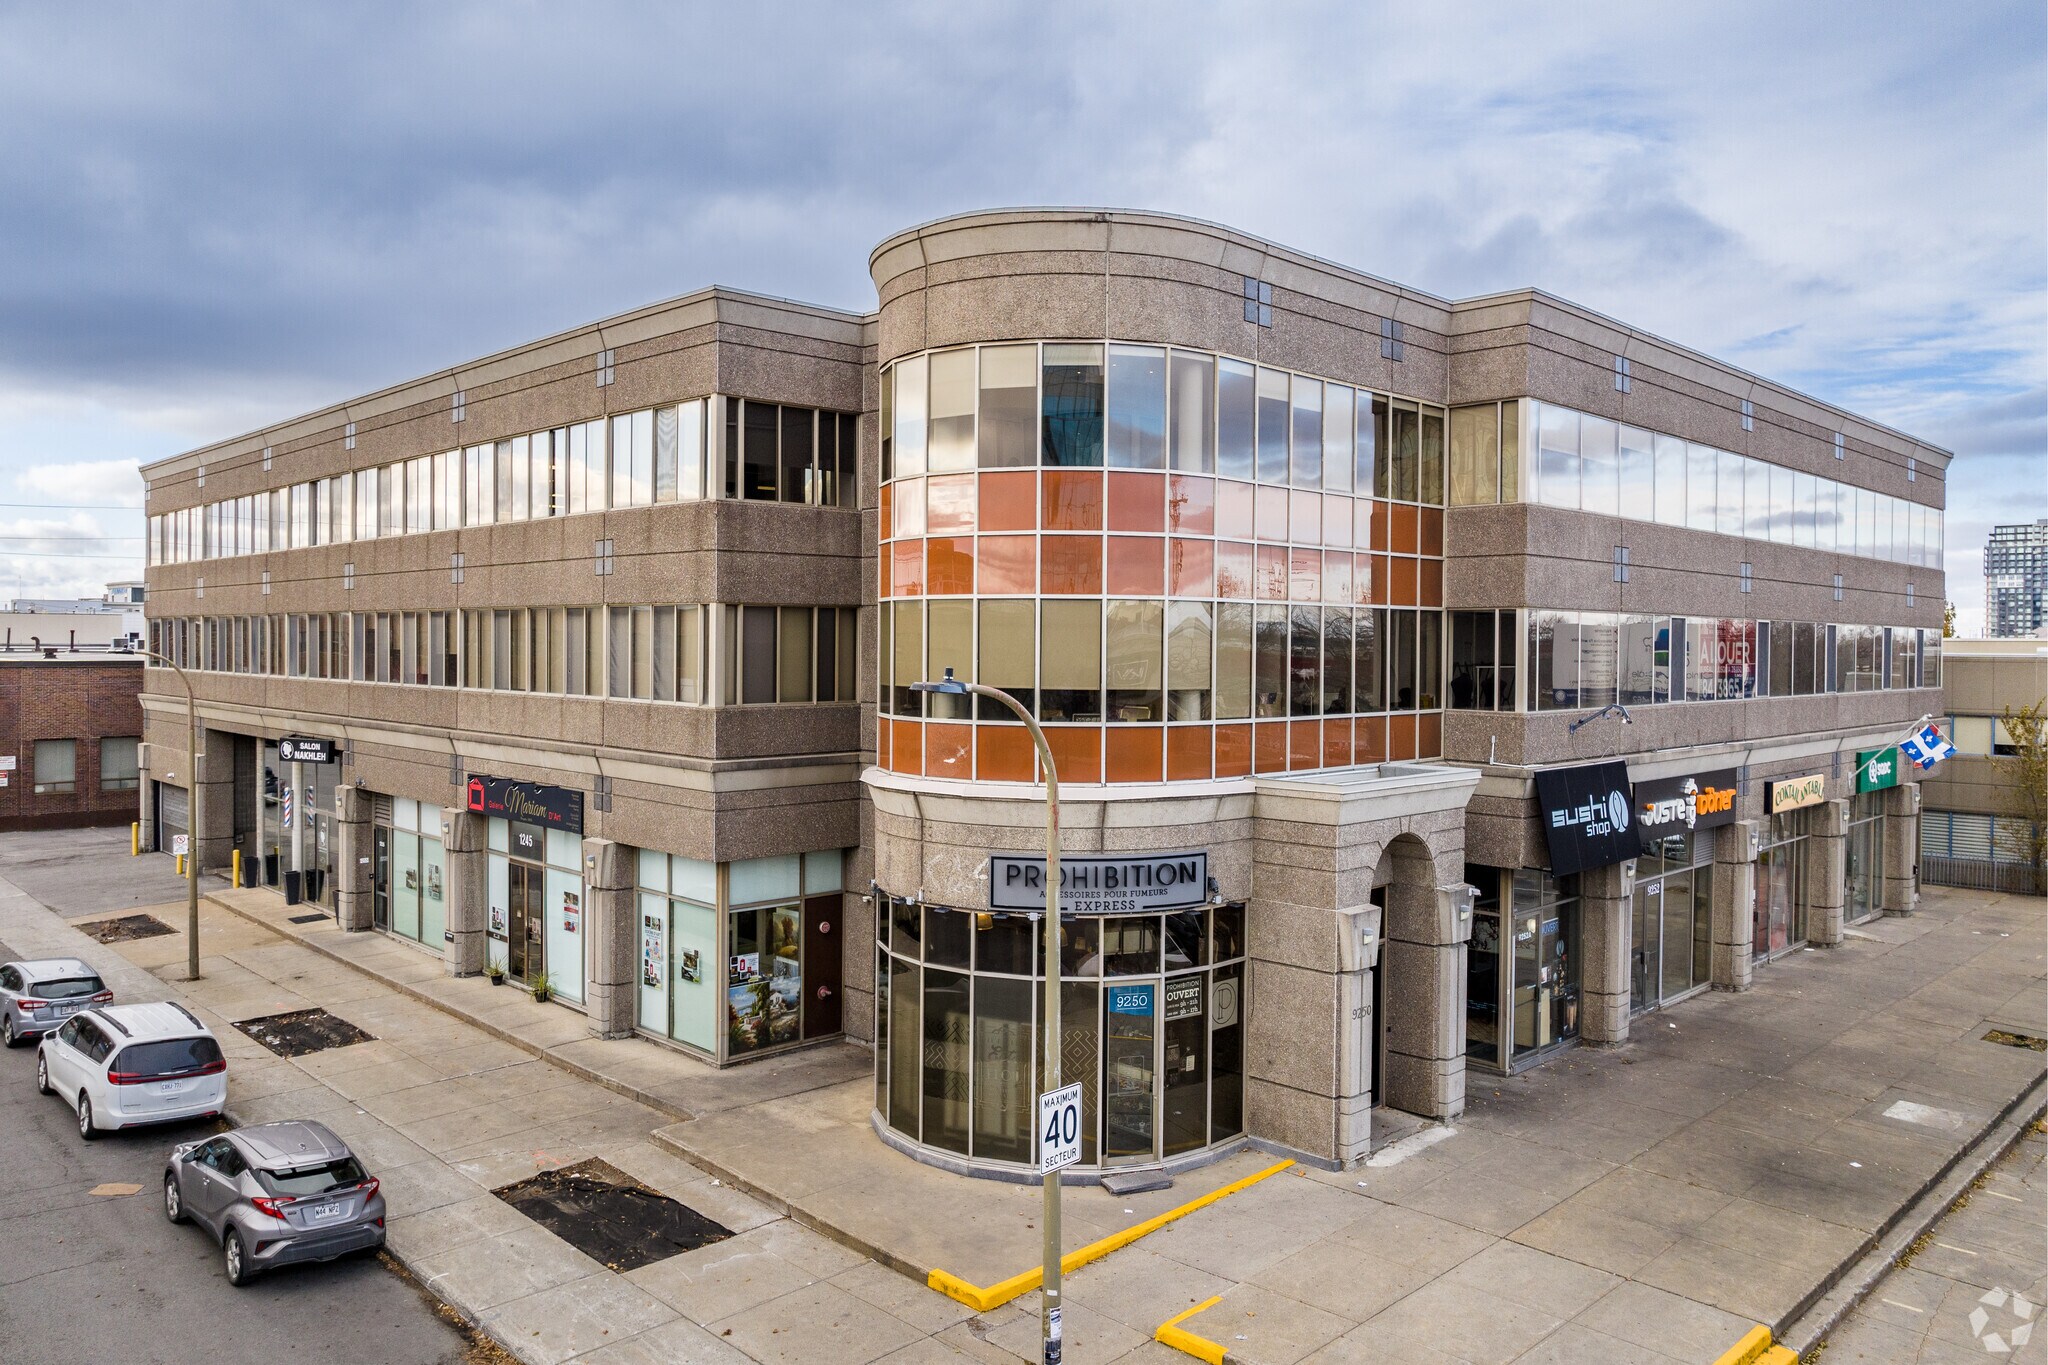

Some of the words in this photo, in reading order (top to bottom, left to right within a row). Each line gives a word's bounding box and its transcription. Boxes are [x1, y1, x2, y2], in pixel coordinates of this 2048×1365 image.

[300, 742, 320, 751] SALON
[294, 750, 326, 761] NAKHLEH
[504, 786, 547, 818] Mariam
[1552, 794, 1607, 828] sushi
[1586, 821, 1611, 837] shop
[519, 833, 533, 847] 1245
[1039, 891, 1101, 899] AESSOIRES
[1104, 890, 1128, 898] POUR
[1130, 888, 1168, 898] FUMEURS
[1075, 900, 1136, 911] EXPRESS
[1166, 981, 1200, 991] PROHIBITION
[1116, 995, 1148, 1007] 9250
[1166, 988, 1200, 1001] OUVERT
[1352, 1005, 1372, 1020] 9250
[1044, 1090, 1078, 1109] MAXIMUM
[1045, 1104, 1077, 1149] 40
[1045, 1147, 1077, 1168] SECTEUR
